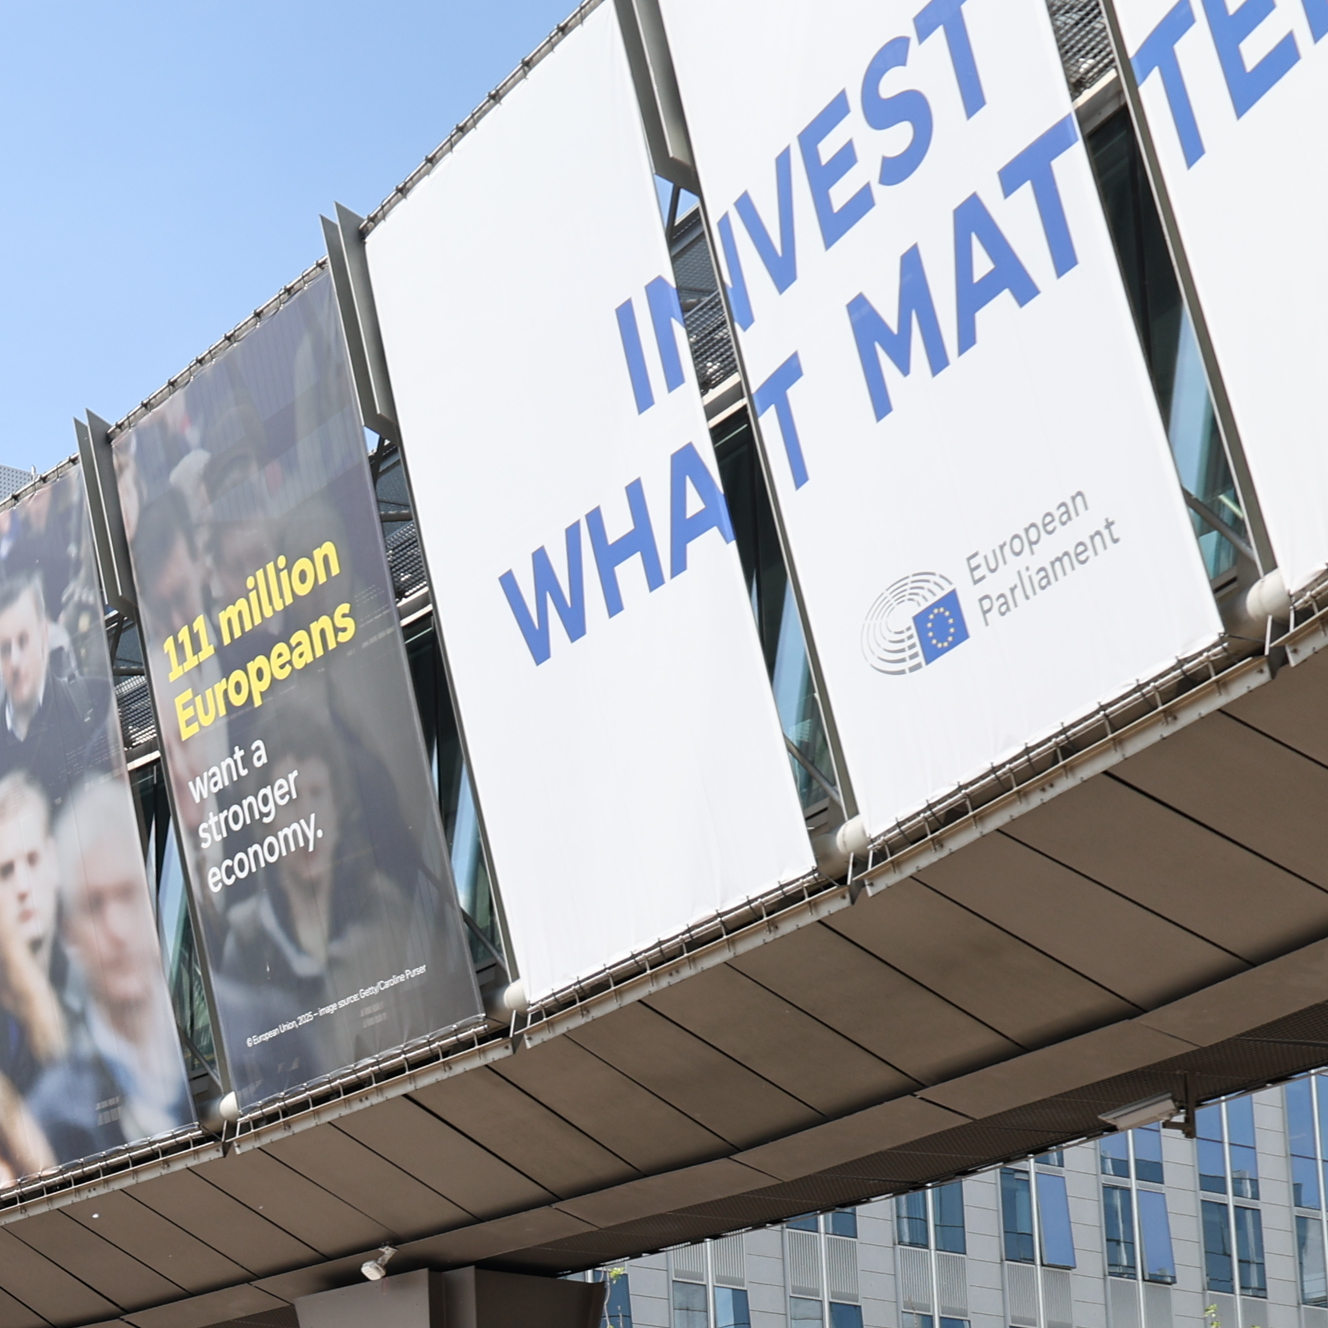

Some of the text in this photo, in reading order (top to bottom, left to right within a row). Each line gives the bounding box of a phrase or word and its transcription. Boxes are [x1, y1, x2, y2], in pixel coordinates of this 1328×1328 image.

[615, 0, 986, 415] INVEST
[498, 0, 1328, 667] WHAT MATTE
[966, 490, 1088, 586] European
[978, 517, 1120, 627] Parliament
[163, 540, 341, 683] 111 million
[174, 602, 356, 742] Europeans
[188, 739, 268, 804] want a
[198, 769, 299, 849] stronger
[207, 812, 324, 893] economy.
[253, 1027, 279, 1045] European
[297, 1011, 314, 1026] 2025
[318, 1001, 337, 1017] image
[405, 964, 427, 981] Purser
